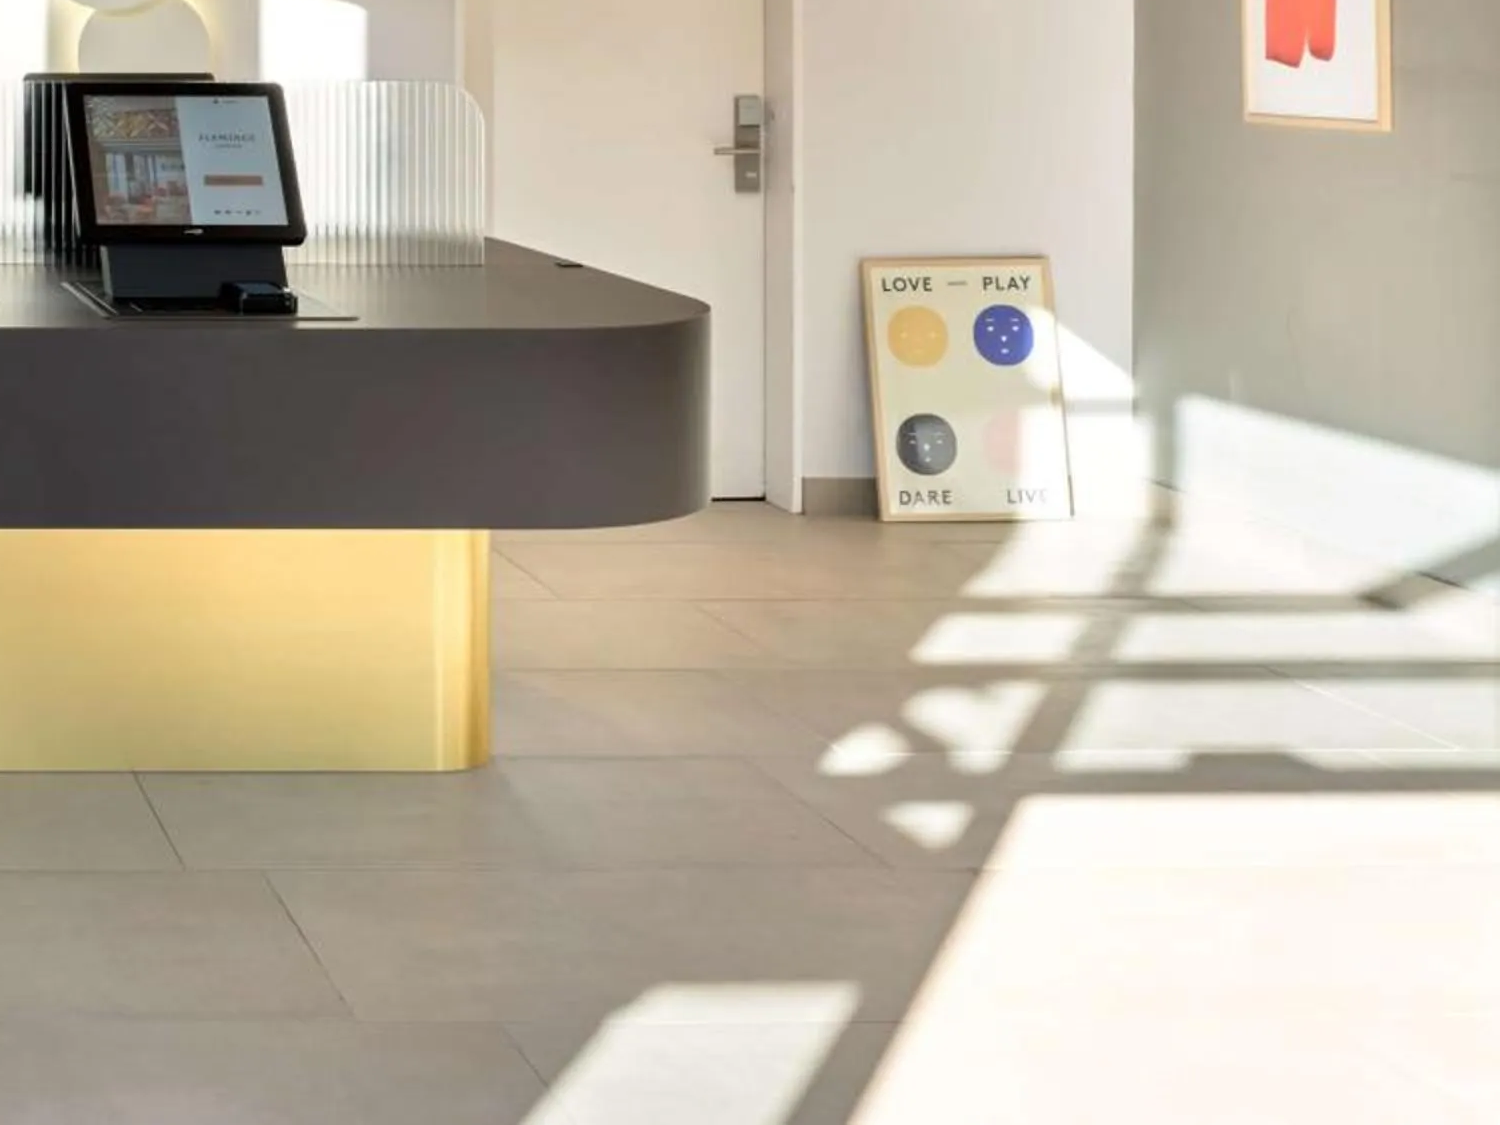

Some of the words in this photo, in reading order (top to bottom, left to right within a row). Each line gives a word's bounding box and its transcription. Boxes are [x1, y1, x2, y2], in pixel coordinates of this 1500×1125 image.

[881, 276, 933, 292] LOVE
[982, 276, 1031, 292] PLAY
[899, 489, 953, 506] DARE
